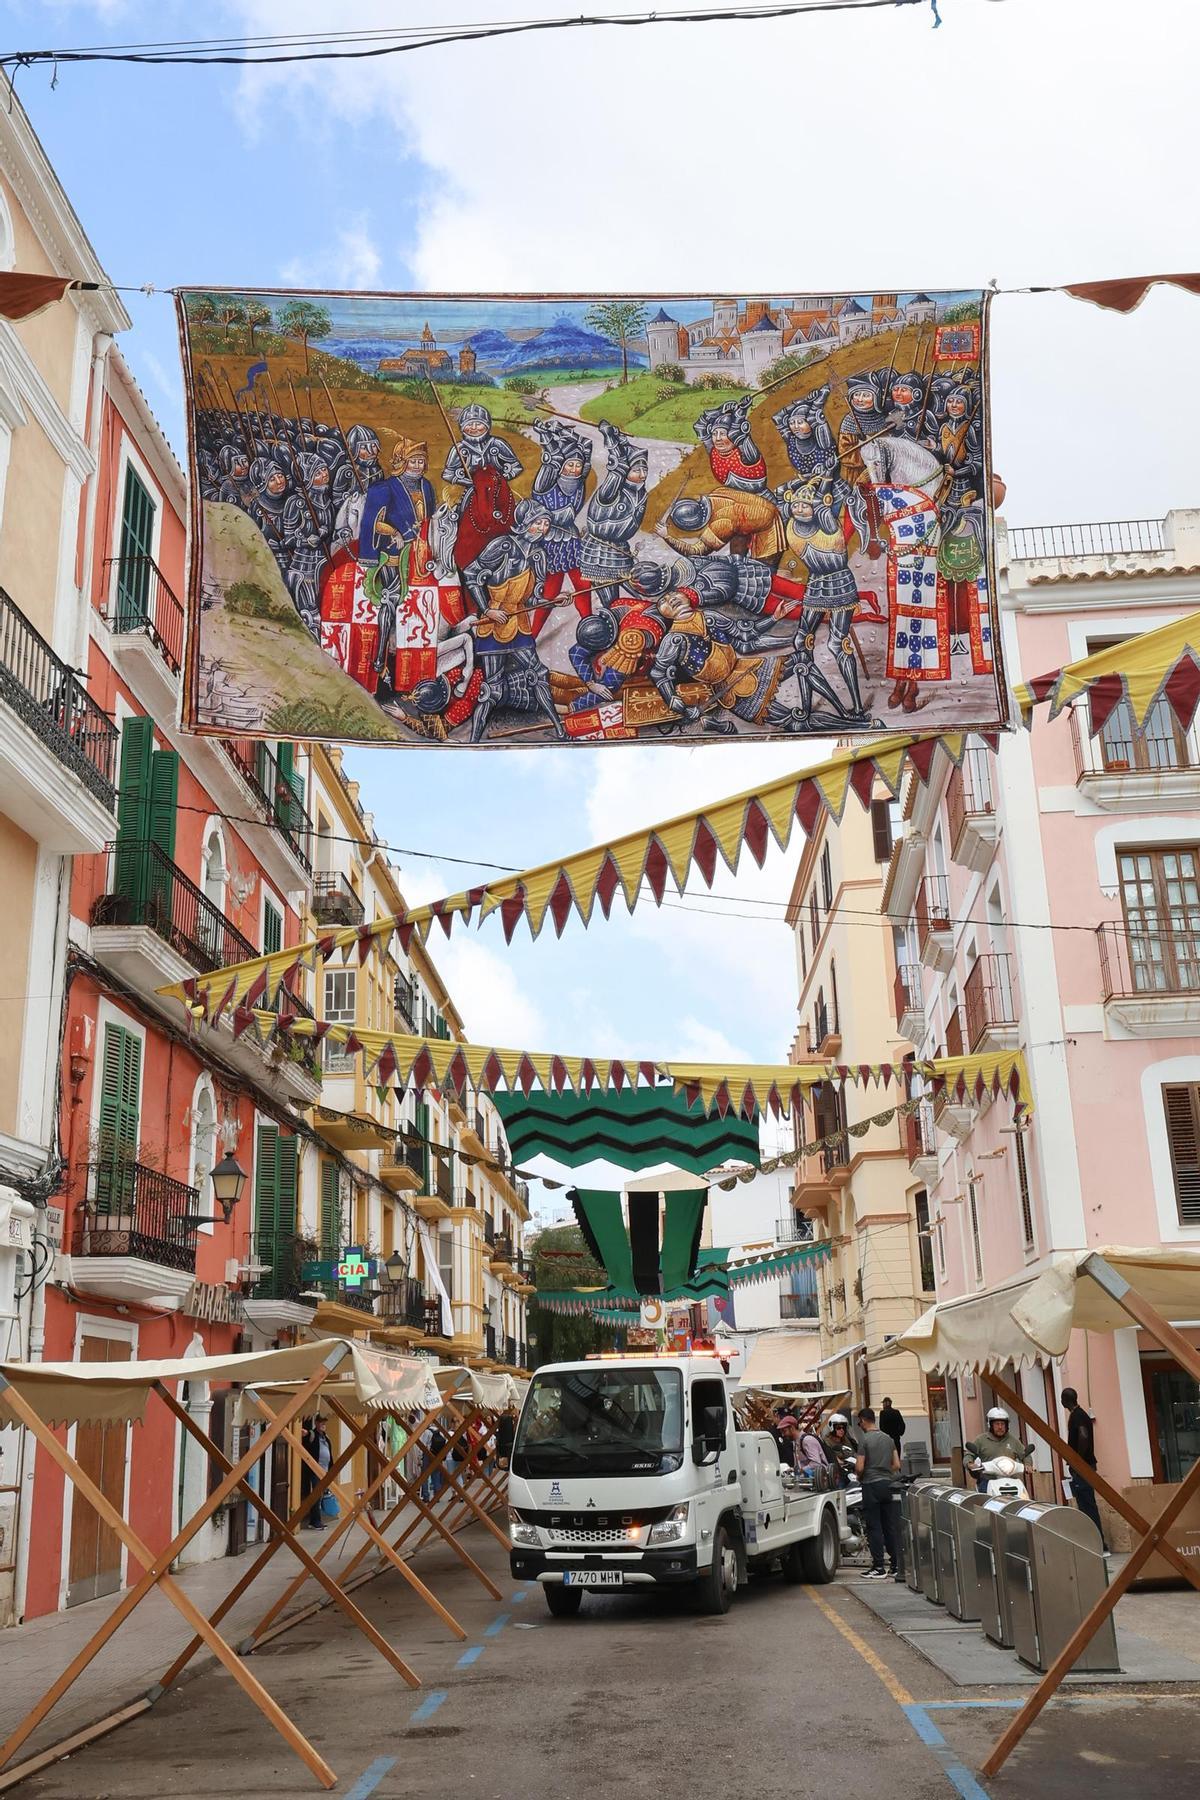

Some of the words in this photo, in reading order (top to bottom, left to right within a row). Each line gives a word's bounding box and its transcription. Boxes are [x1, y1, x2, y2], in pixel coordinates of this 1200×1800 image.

[340, 1264, 365, 1275] CIA
[551, 1516, 633, 1526] FUSO
[570, 1572, 597, 1584] 7470
[600, 1571, 621, 1584] MHW
